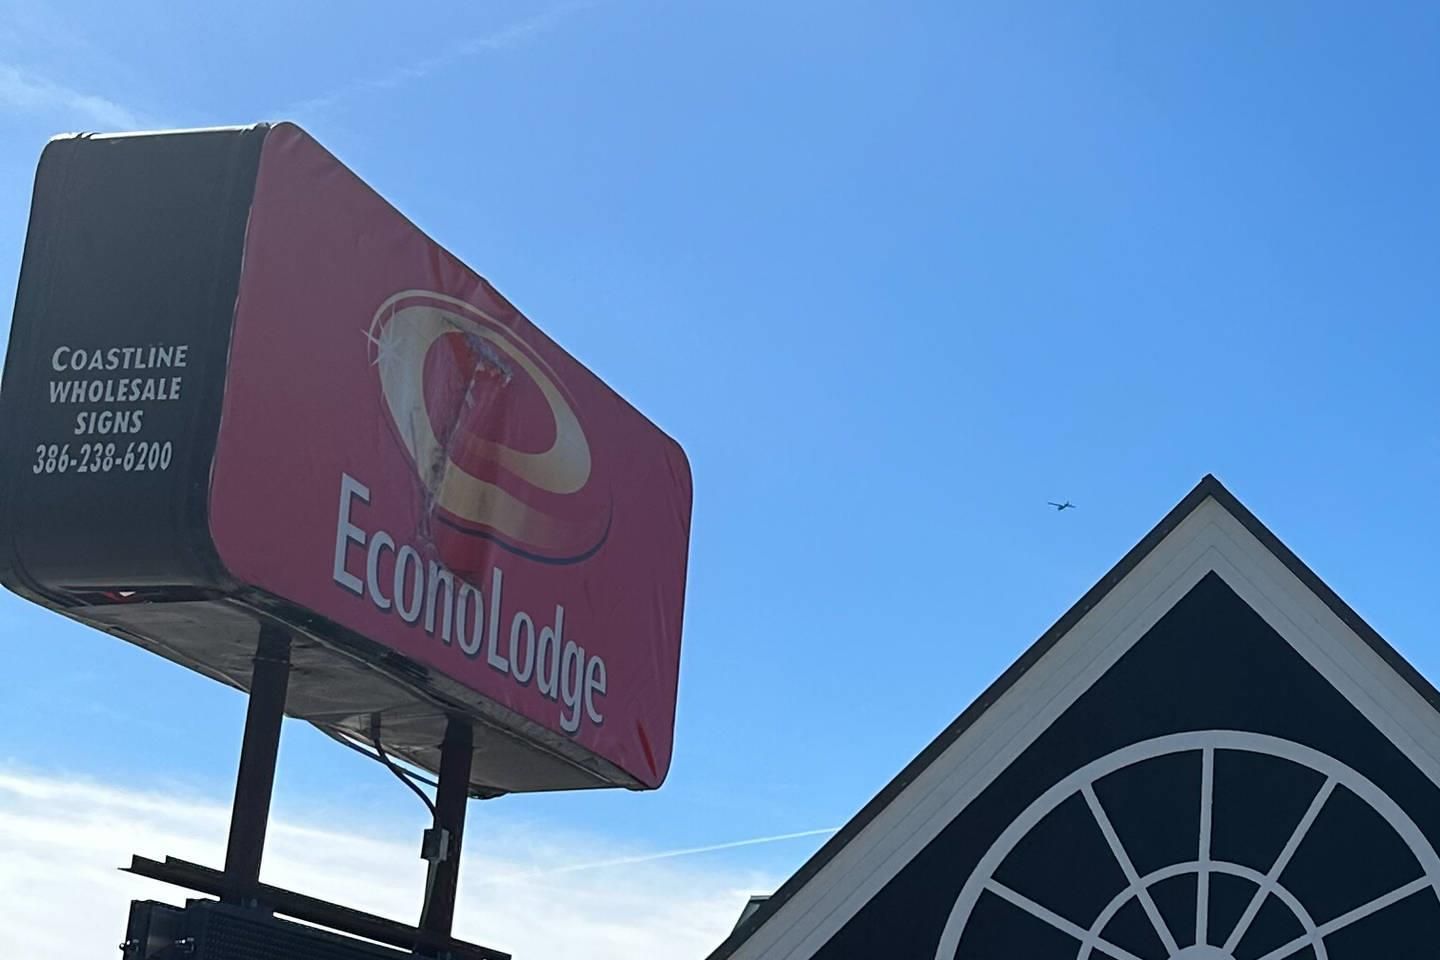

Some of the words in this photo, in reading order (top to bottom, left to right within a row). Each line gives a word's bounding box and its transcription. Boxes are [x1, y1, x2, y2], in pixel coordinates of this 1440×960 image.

[50, 377, 182, 403] WHOLESALE
[74, 410, 143, 435] SIGNS
[33, 441, 172, 474] 386-238-6200
